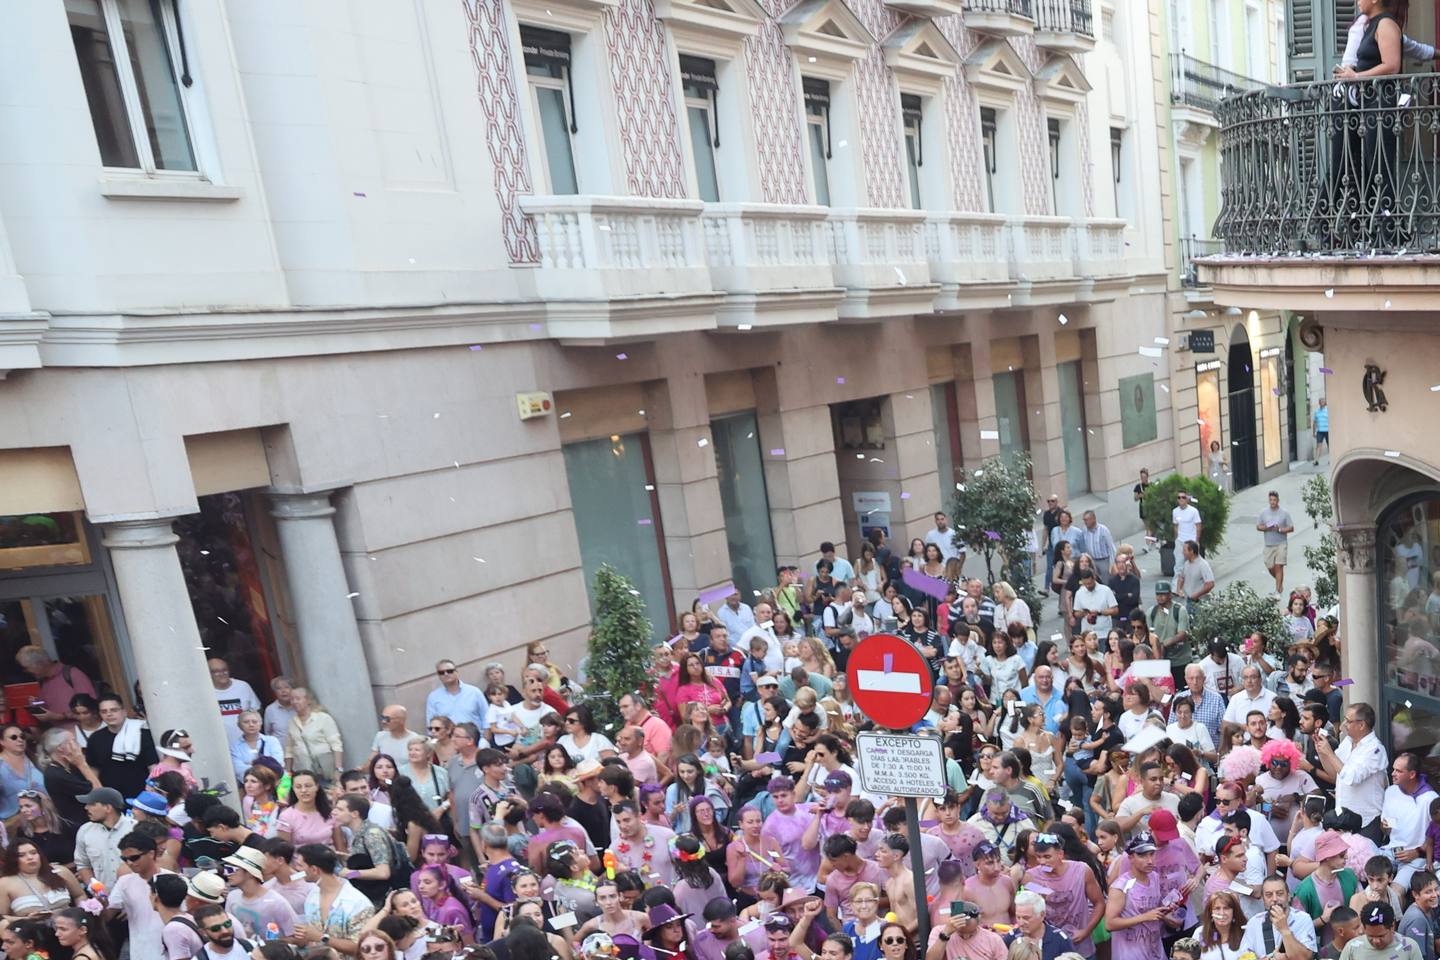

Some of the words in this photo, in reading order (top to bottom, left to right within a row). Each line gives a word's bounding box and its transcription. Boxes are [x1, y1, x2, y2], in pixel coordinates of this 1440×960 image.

[875, 737, 921, 748] EXCEPTO
[865, 746, 888, 754] CAA
[873, 776, 898, 785] ACCESO
[906, 779, 935, 787] HOTELES
[894, 785, 940, 794] AUTORIZADOS
